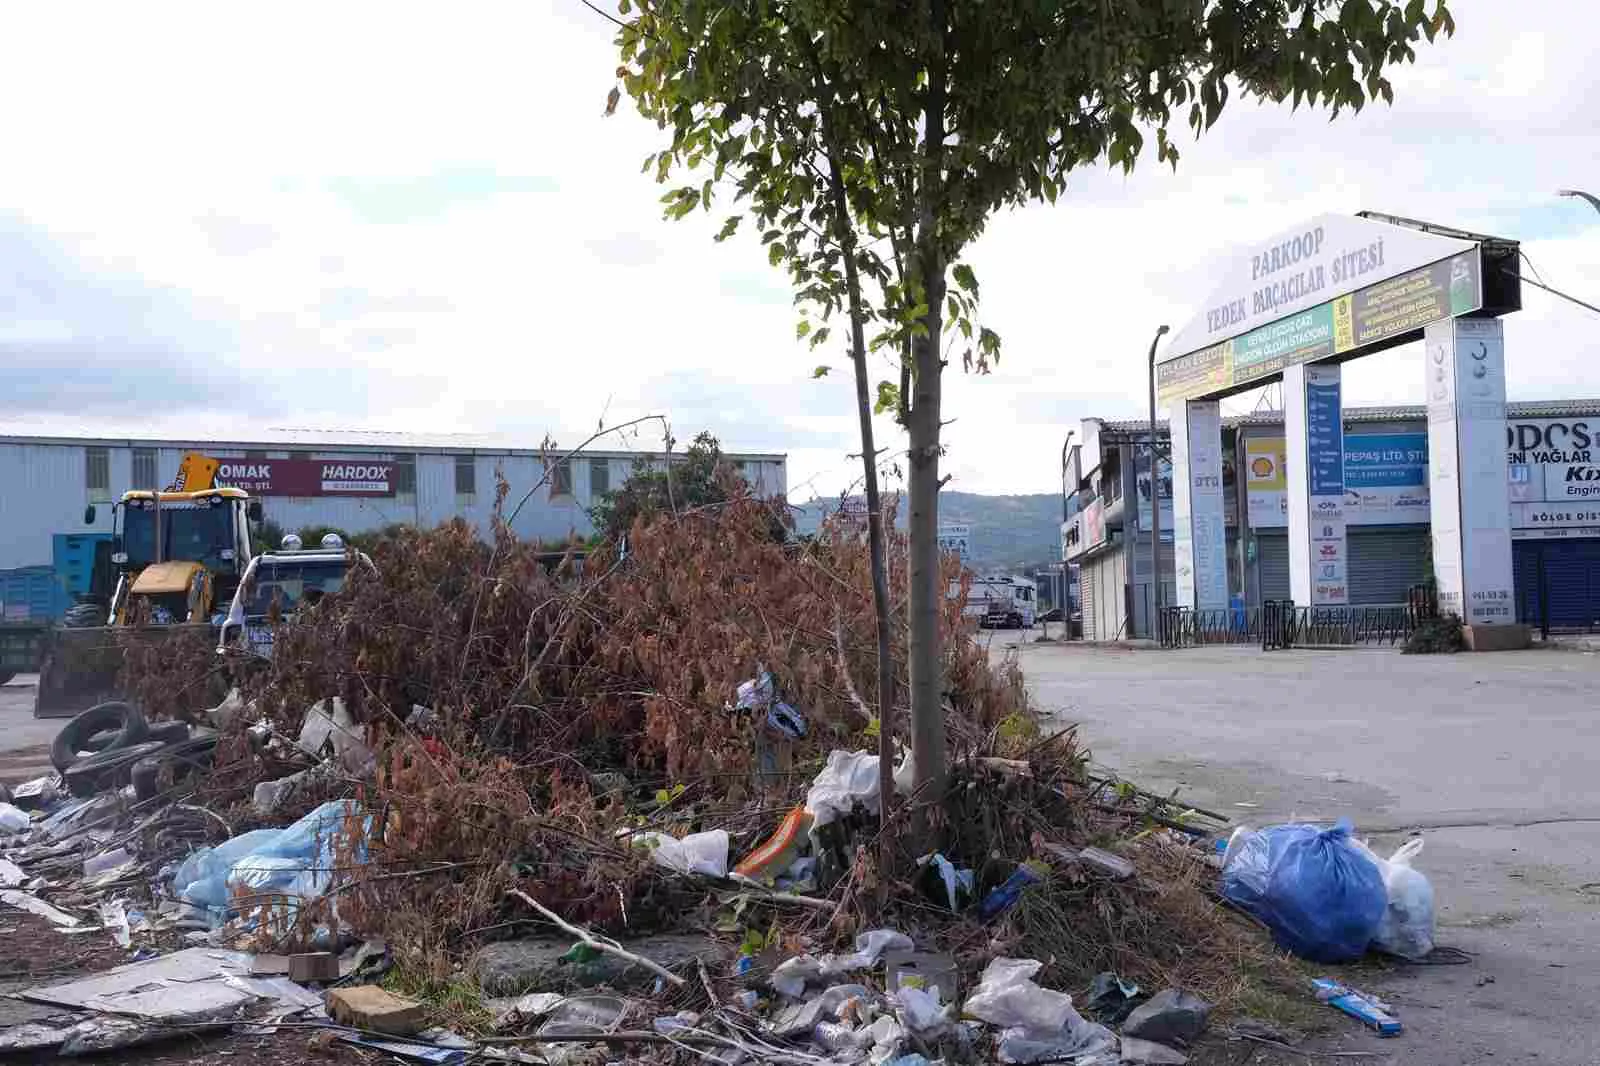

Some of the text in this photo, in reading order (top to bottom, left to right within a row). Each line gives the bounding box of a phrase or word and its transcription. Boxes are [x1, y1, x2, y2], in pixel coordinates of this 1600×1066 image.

[1252, 227, 1324, 280] PARKOOP
[1207, 298, 1246, 333] YEDEK
[1253, 266, 1325, 314] PARÇACILAR
[1332, 235, 1385, 285] SİTESİ
[1532, 448, 1592, 464] YAĞLAR
[219, 464, 271, 479] OMAK
[322, 465, 388, 479] HARDOX
[1532, 511, 1571, 522] BÖLGE
